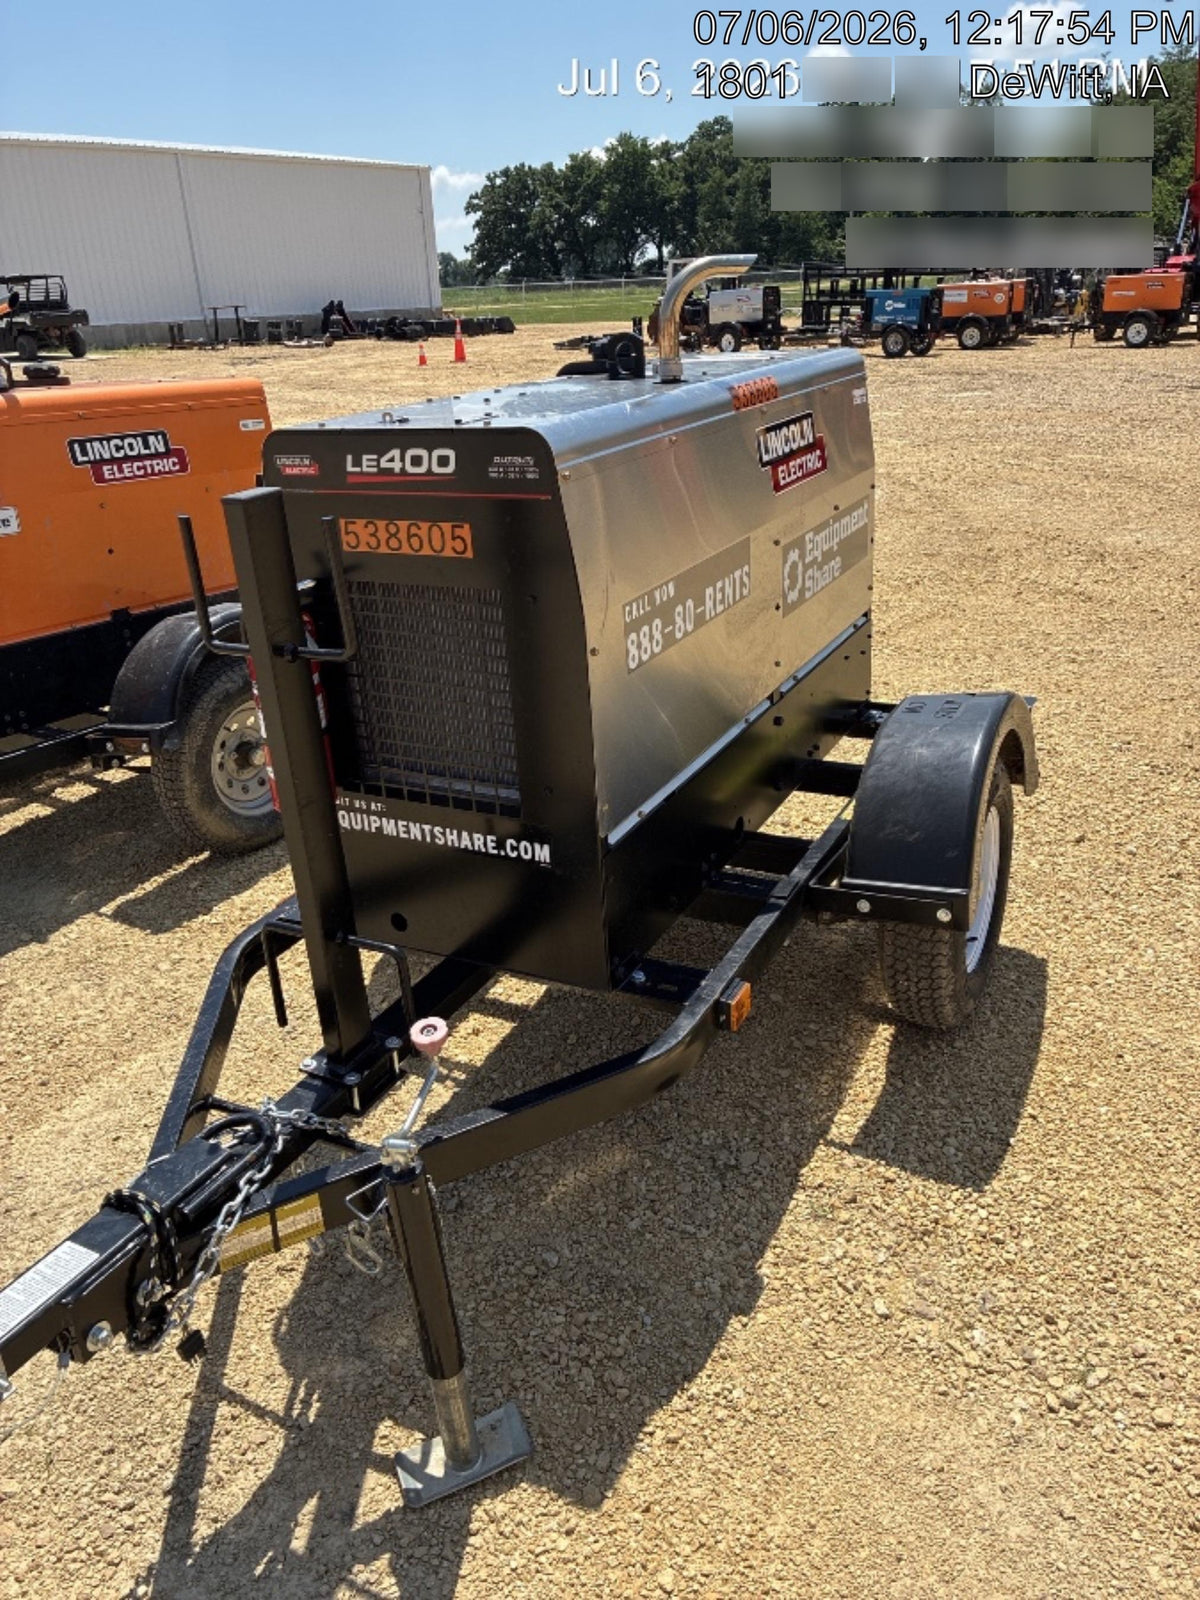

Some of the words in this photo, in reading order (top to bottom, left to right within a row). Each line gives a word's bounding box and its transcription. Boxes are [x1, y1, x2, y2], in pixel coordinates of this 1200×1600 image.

[73, 434, 166, 462] LINCOLN
[759, 417, 813, 462] LINCOLN
[102, 457, 180, 480] ELECTRIC
[346, 448, 456, 474] LE400
[777, 449, 823, 486] ELECTRIC
[343, 520, 469, 556] 538605
[805, 502, 868, 564] Equipment
[805, 555, 842, 600] Share
[625, 594, 651, 623] CALL
[627, 564, 749, 670] 888-80-RENTS
[337, 809, 550, 864] QUIPMENTSHARE.COM
